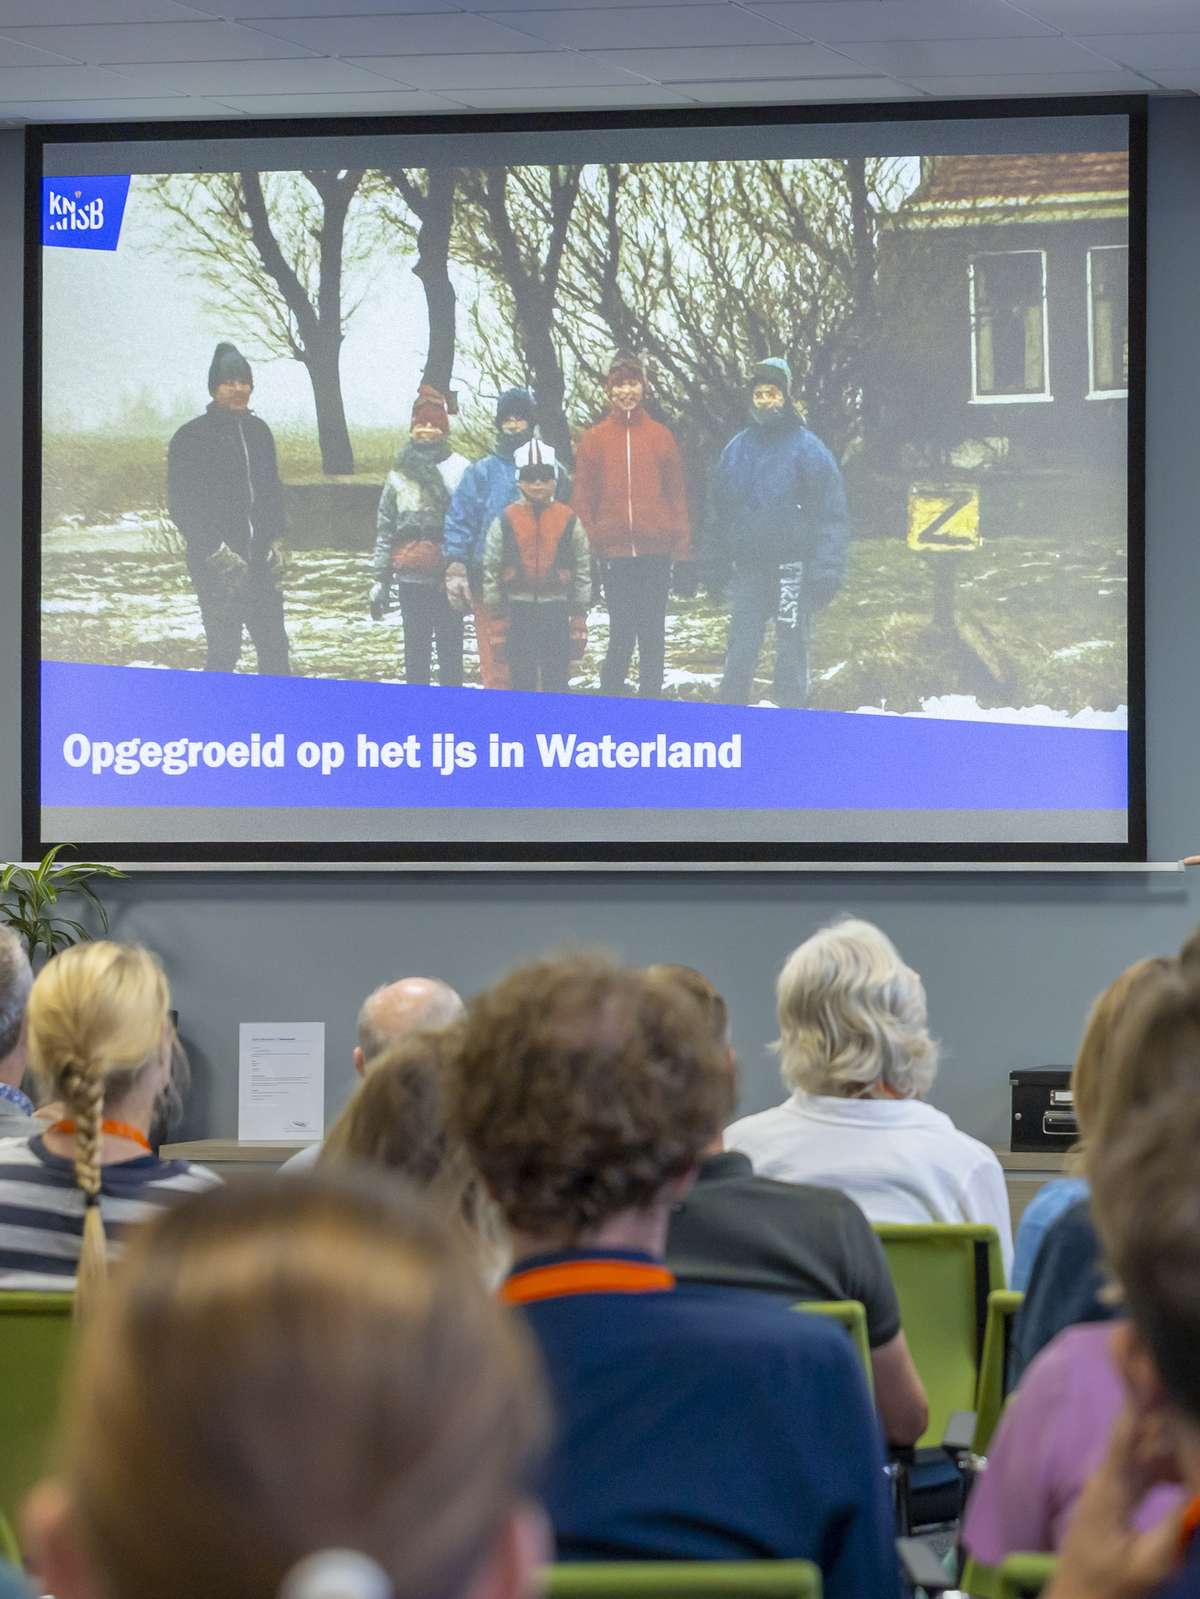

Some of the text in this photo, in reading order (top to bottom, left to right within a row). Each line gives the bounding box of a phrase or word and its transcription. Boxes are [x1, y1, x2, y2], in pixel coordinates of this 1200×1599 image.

[49, 191, 105, 231] KNSB
[62, 733, 743, 776] Opgegroeid op het ijs in Waterland
